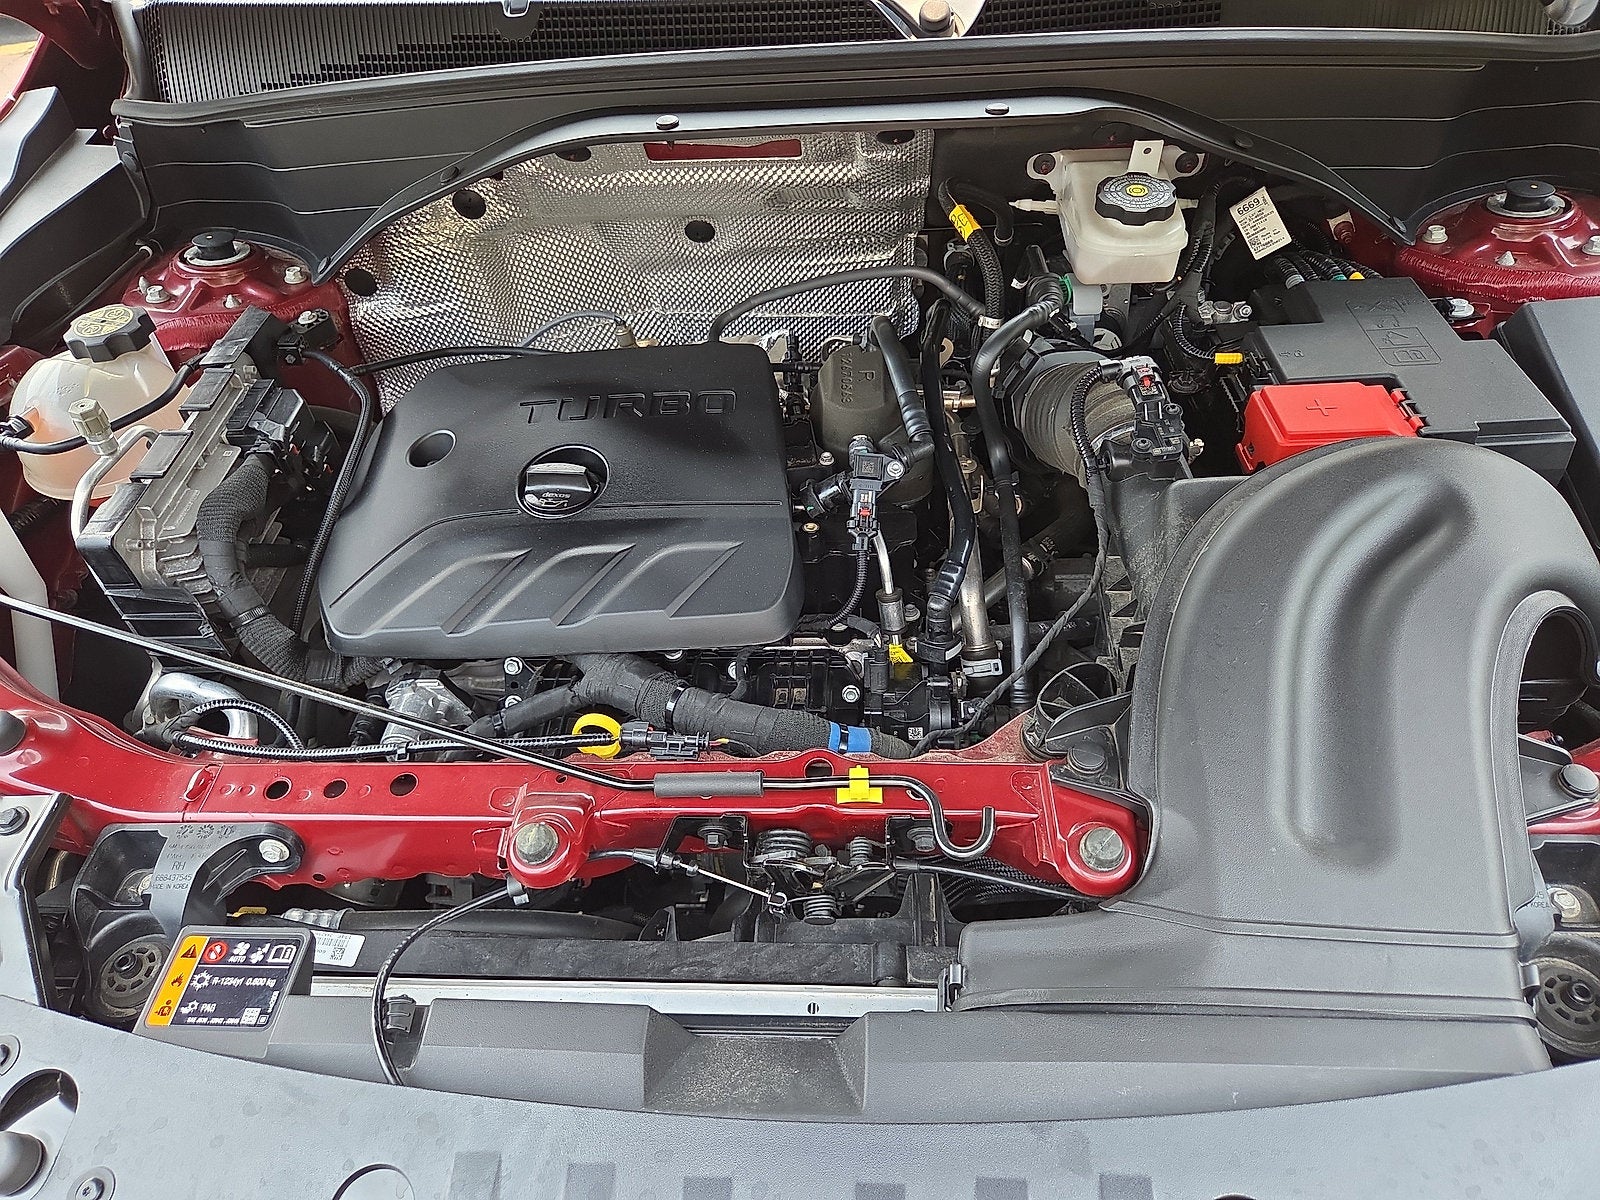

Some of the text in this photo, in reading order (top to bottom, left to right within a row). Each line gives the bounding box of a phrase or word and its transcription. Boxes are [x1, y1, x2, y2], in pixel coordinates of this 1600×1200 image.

[1236, 197, 1261, 216] 6669
[858, 370, 876, 382] R
[519, 388, 737, 424] TURBO
[171, 861, 186, 871] RH
[228, 955, 247, 963] AUTO
[200, 1003, 217, 1013] PAG
